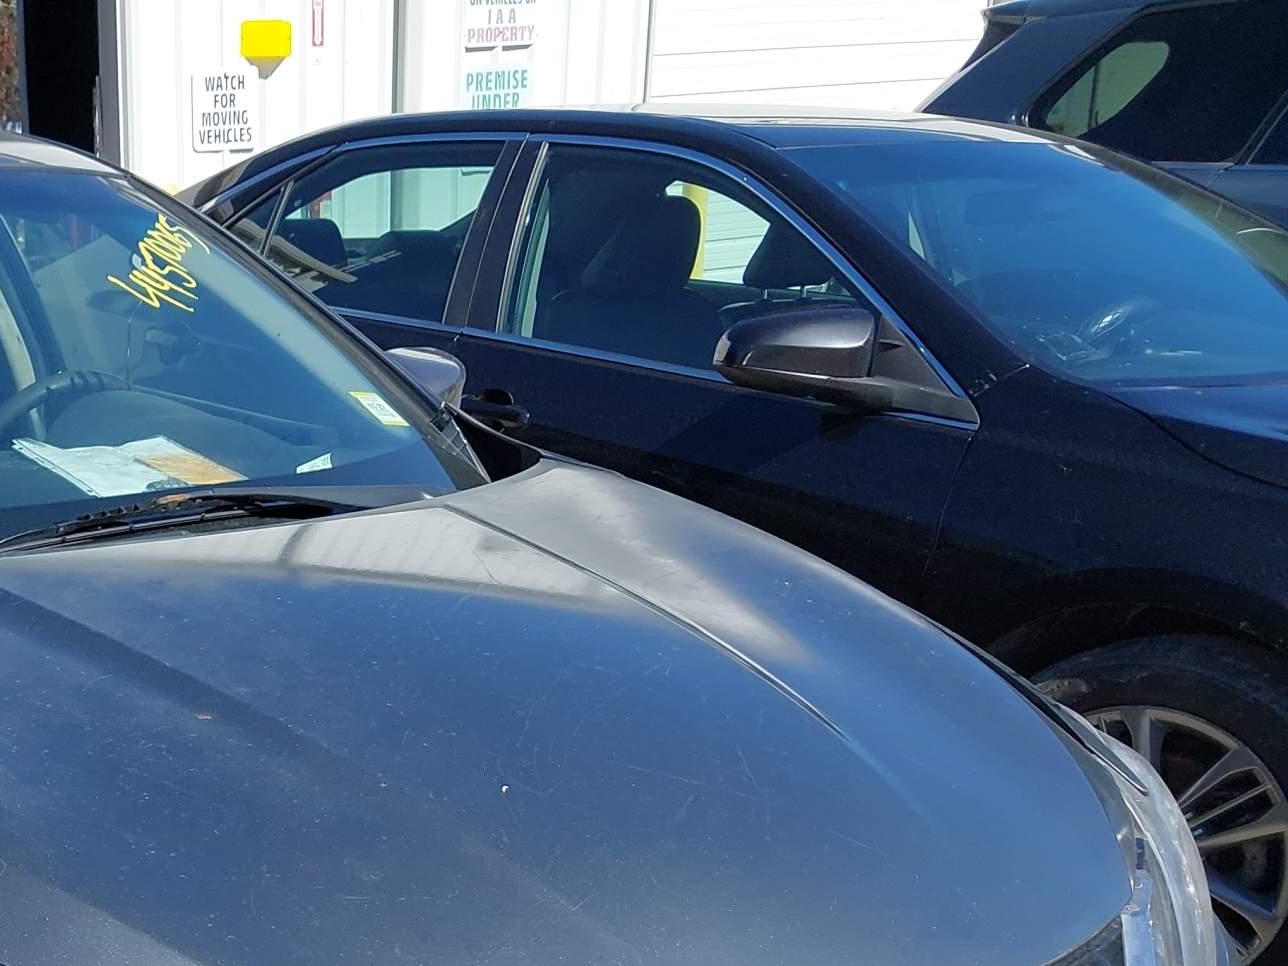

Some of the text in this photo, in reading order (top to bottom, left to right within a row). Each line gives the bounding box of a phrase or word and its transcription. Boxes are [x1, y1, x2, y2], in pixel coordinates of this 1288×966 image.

[467, 24, 535, 43] PROPERTY
[204, 73, 245, 92] WATCH
[466, 69, 528, 93] PREMISE
[213, 92, 236, 109] FOR
[201, 109, 249, 127] MOVING
[198, 126, 252, 145] VEHICLES
